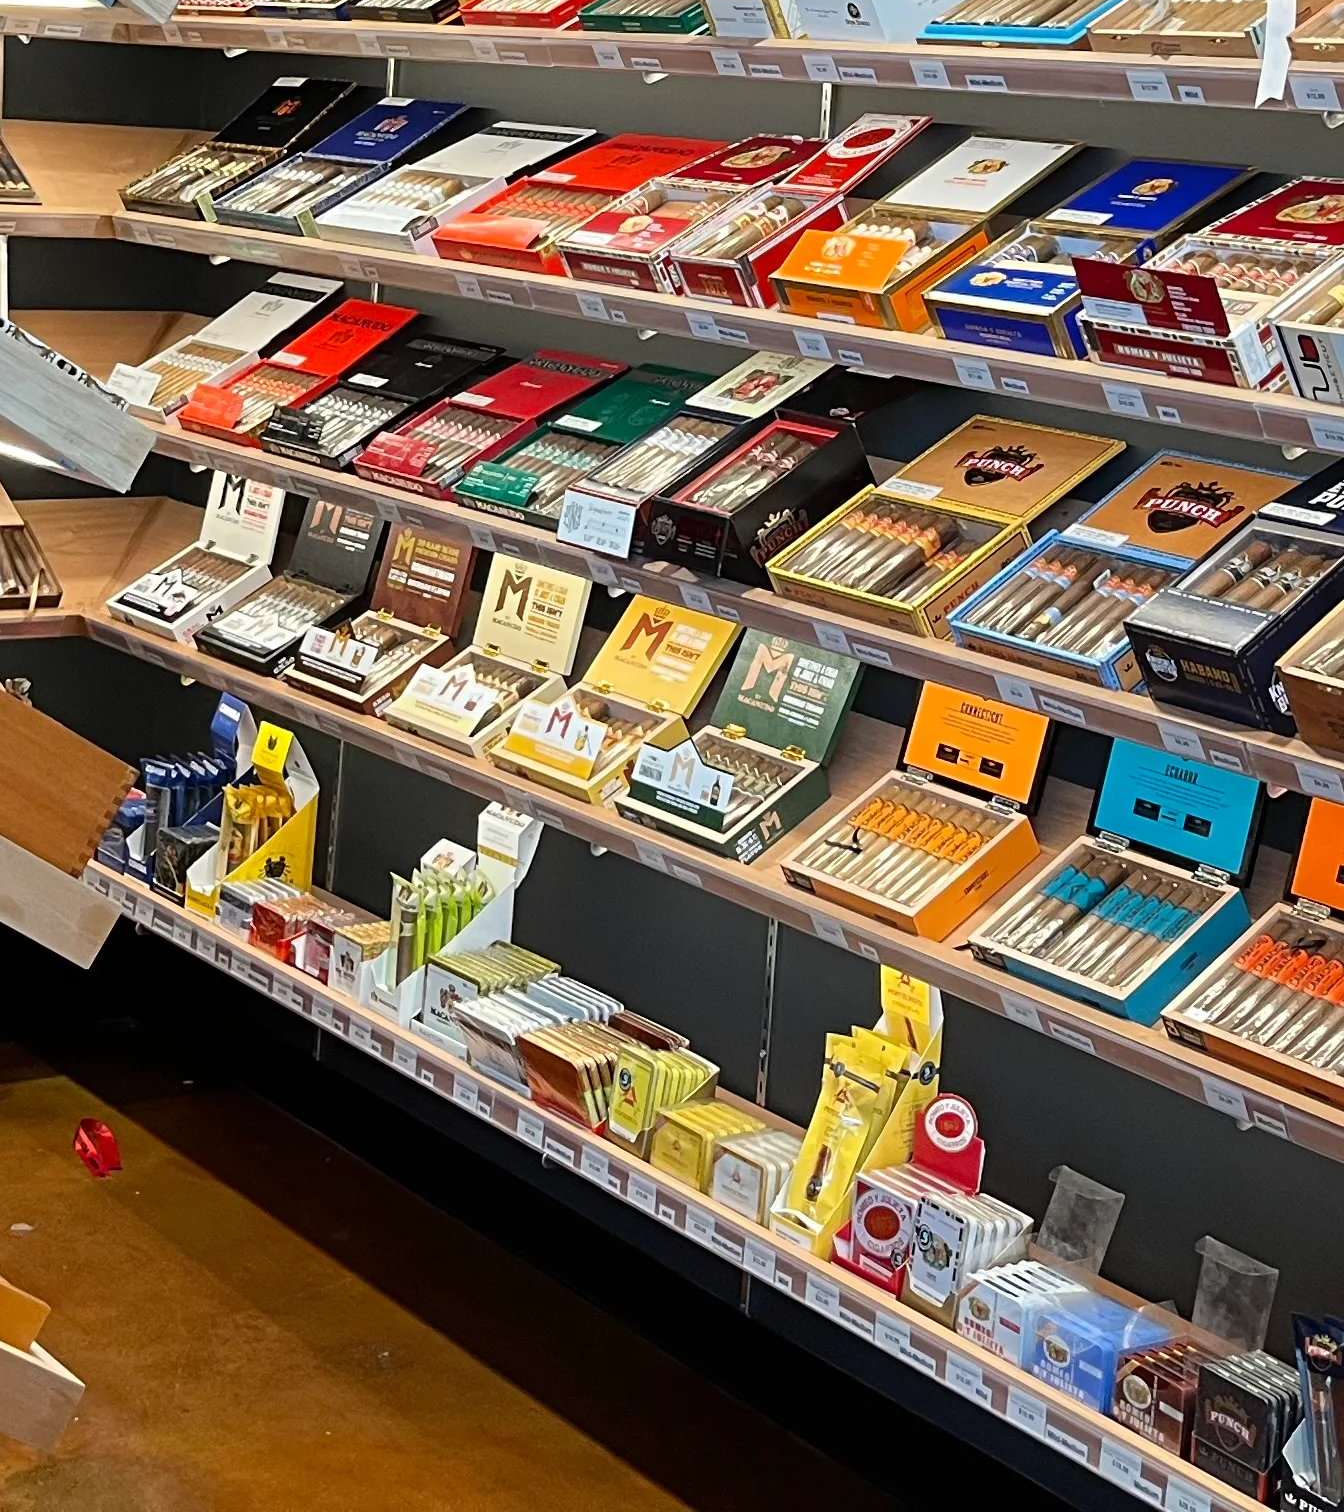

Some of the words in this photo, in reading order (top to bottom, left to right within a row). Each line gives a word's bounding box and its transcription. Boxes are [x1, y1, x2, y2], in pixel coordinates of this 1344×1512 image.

[963, 456, 1026, 478] PUNCH
[1146, 496, 1221, 523] PUNCH
[758, 521, 807, 561] PUNCH
[531, 602, 546, 614] THIS
[665, 643, 680, 657] THIS
[1165, 764, 1199, 785] ECUADOR
[1210, 1410, 1250, 1440] PUNCH
